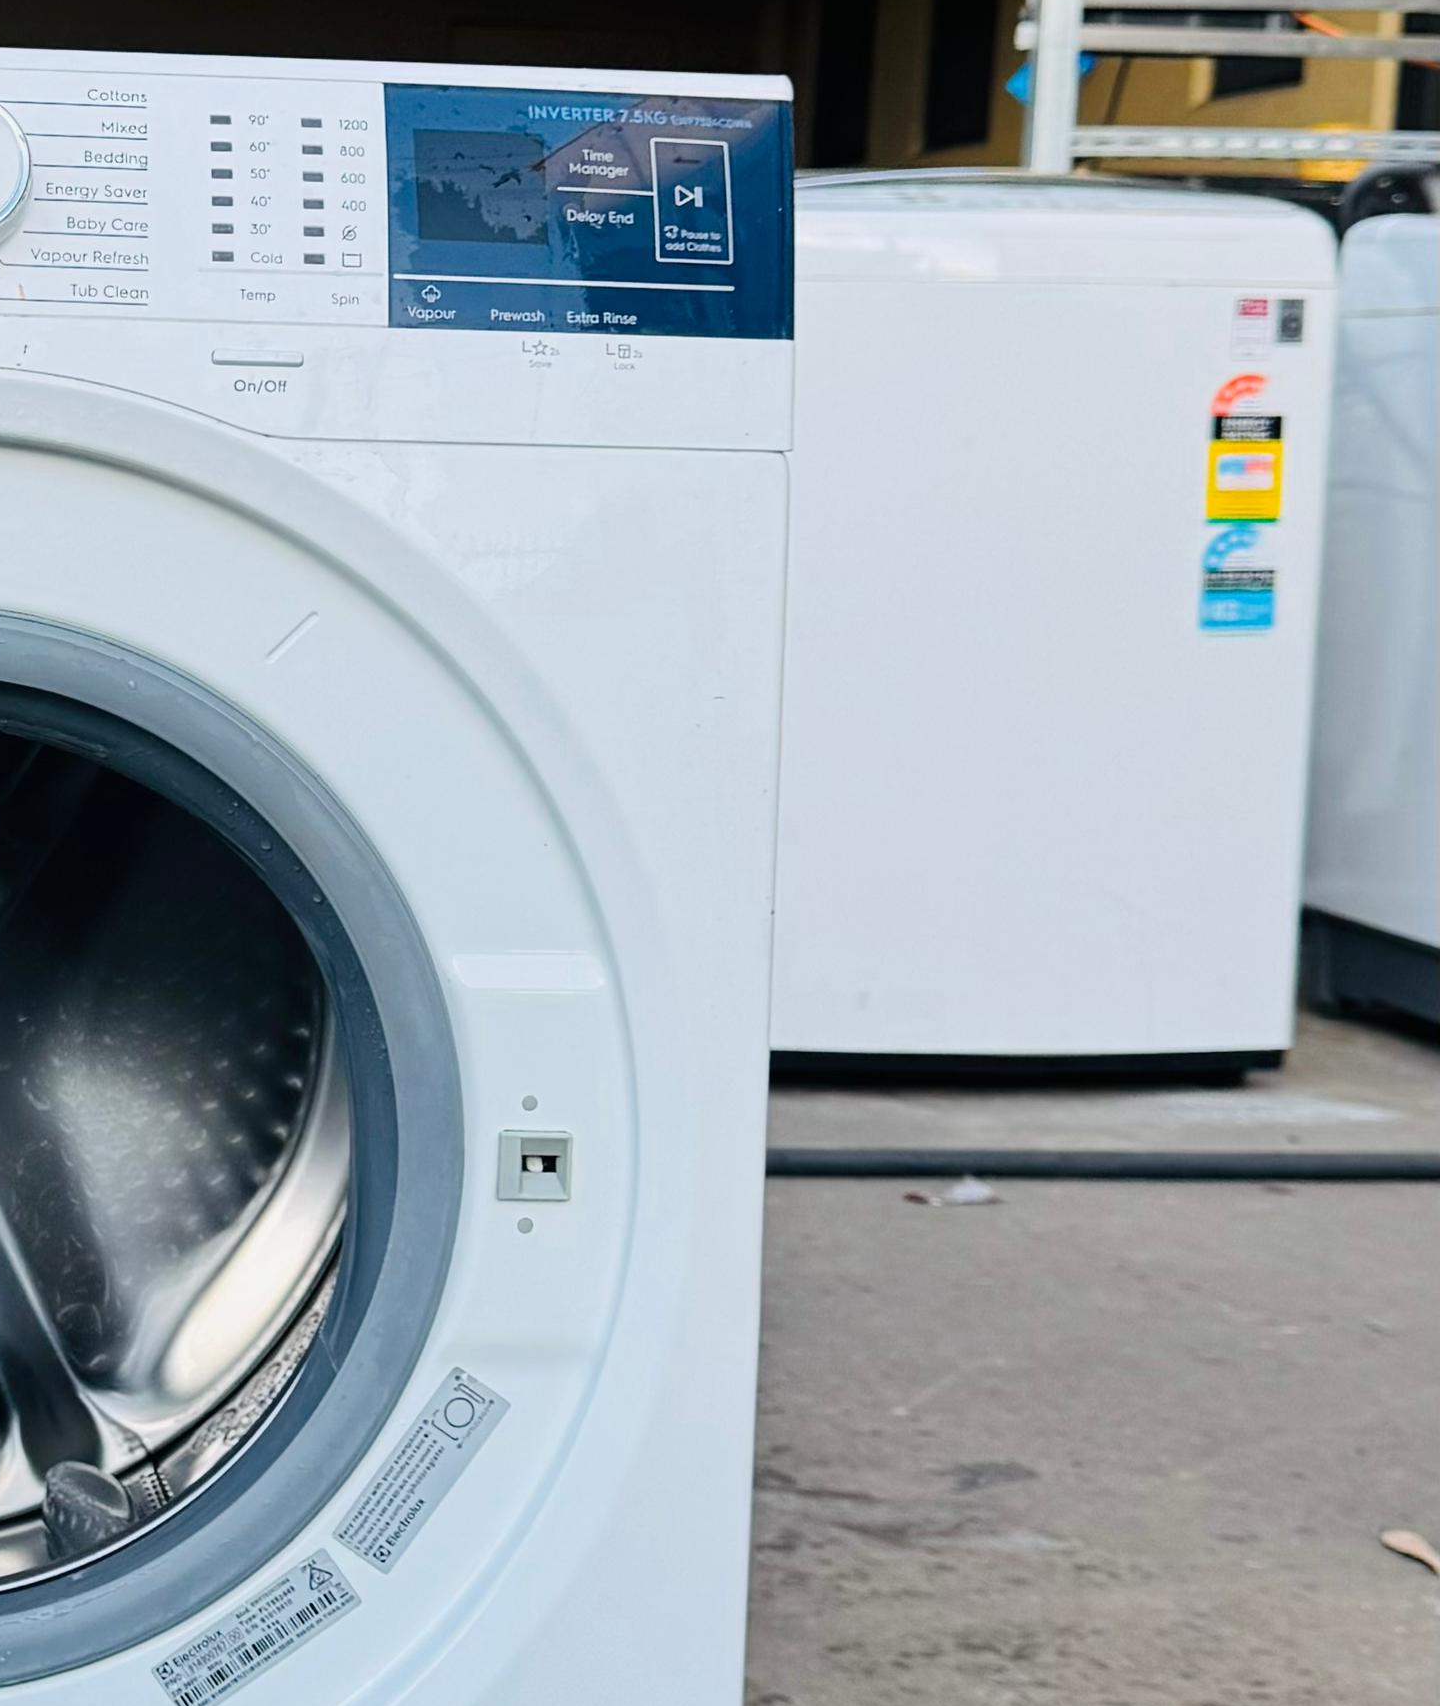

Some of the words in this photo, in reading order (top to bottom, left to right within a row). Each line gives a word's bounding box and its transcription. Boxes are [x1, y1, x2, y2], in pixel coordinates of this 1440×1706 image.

[87, 89, 148, 102] Cottons
[528, 105, 615, 123] INVERTER
[620, 111, 666, 125] 7.5KG
[102, 121, 148, 135] Mixed
[339, 119, 368, 131] 1200
[84, 151, 148, 167] Bedding
[340, 146, 365, 157] 800
[582, 148, 614, 163] Time
[340, 173, 366, 184] 600
[569, 162, 629, 179] Manager
[45, 183, 98, 200] Energy
[104, 185, 148, 199] Saver
[341, 200, 367, 212] 400
[66, 216, 107, 233] Baby
[111, 218, 148, 232] Care
[567, 209, 606, 226] Delay
[609, 210, 634, 225] End
[31, 248, 88, 263] Vapour
[93, 250, 149, 264] Refresh
[250, 252, 283, 264] Cold
[70, 284, 96, 298] Tub
[104, 286, 149, 300] Clean
[240, 290, 275, 306] Temp
[331, 291, 360, 308] Spin
[408, 306, 456, 321] Vapour
[490, 308, 545, 324] Prewash
[567, 310, 599, 325] Extra
[603, 311, 637, 325] Rinse
[234, 379, 287, 394] On/Off
[384, 1496, 426, 1547] Electrolux
[172, 1627, 223, 1667] Electrolux
